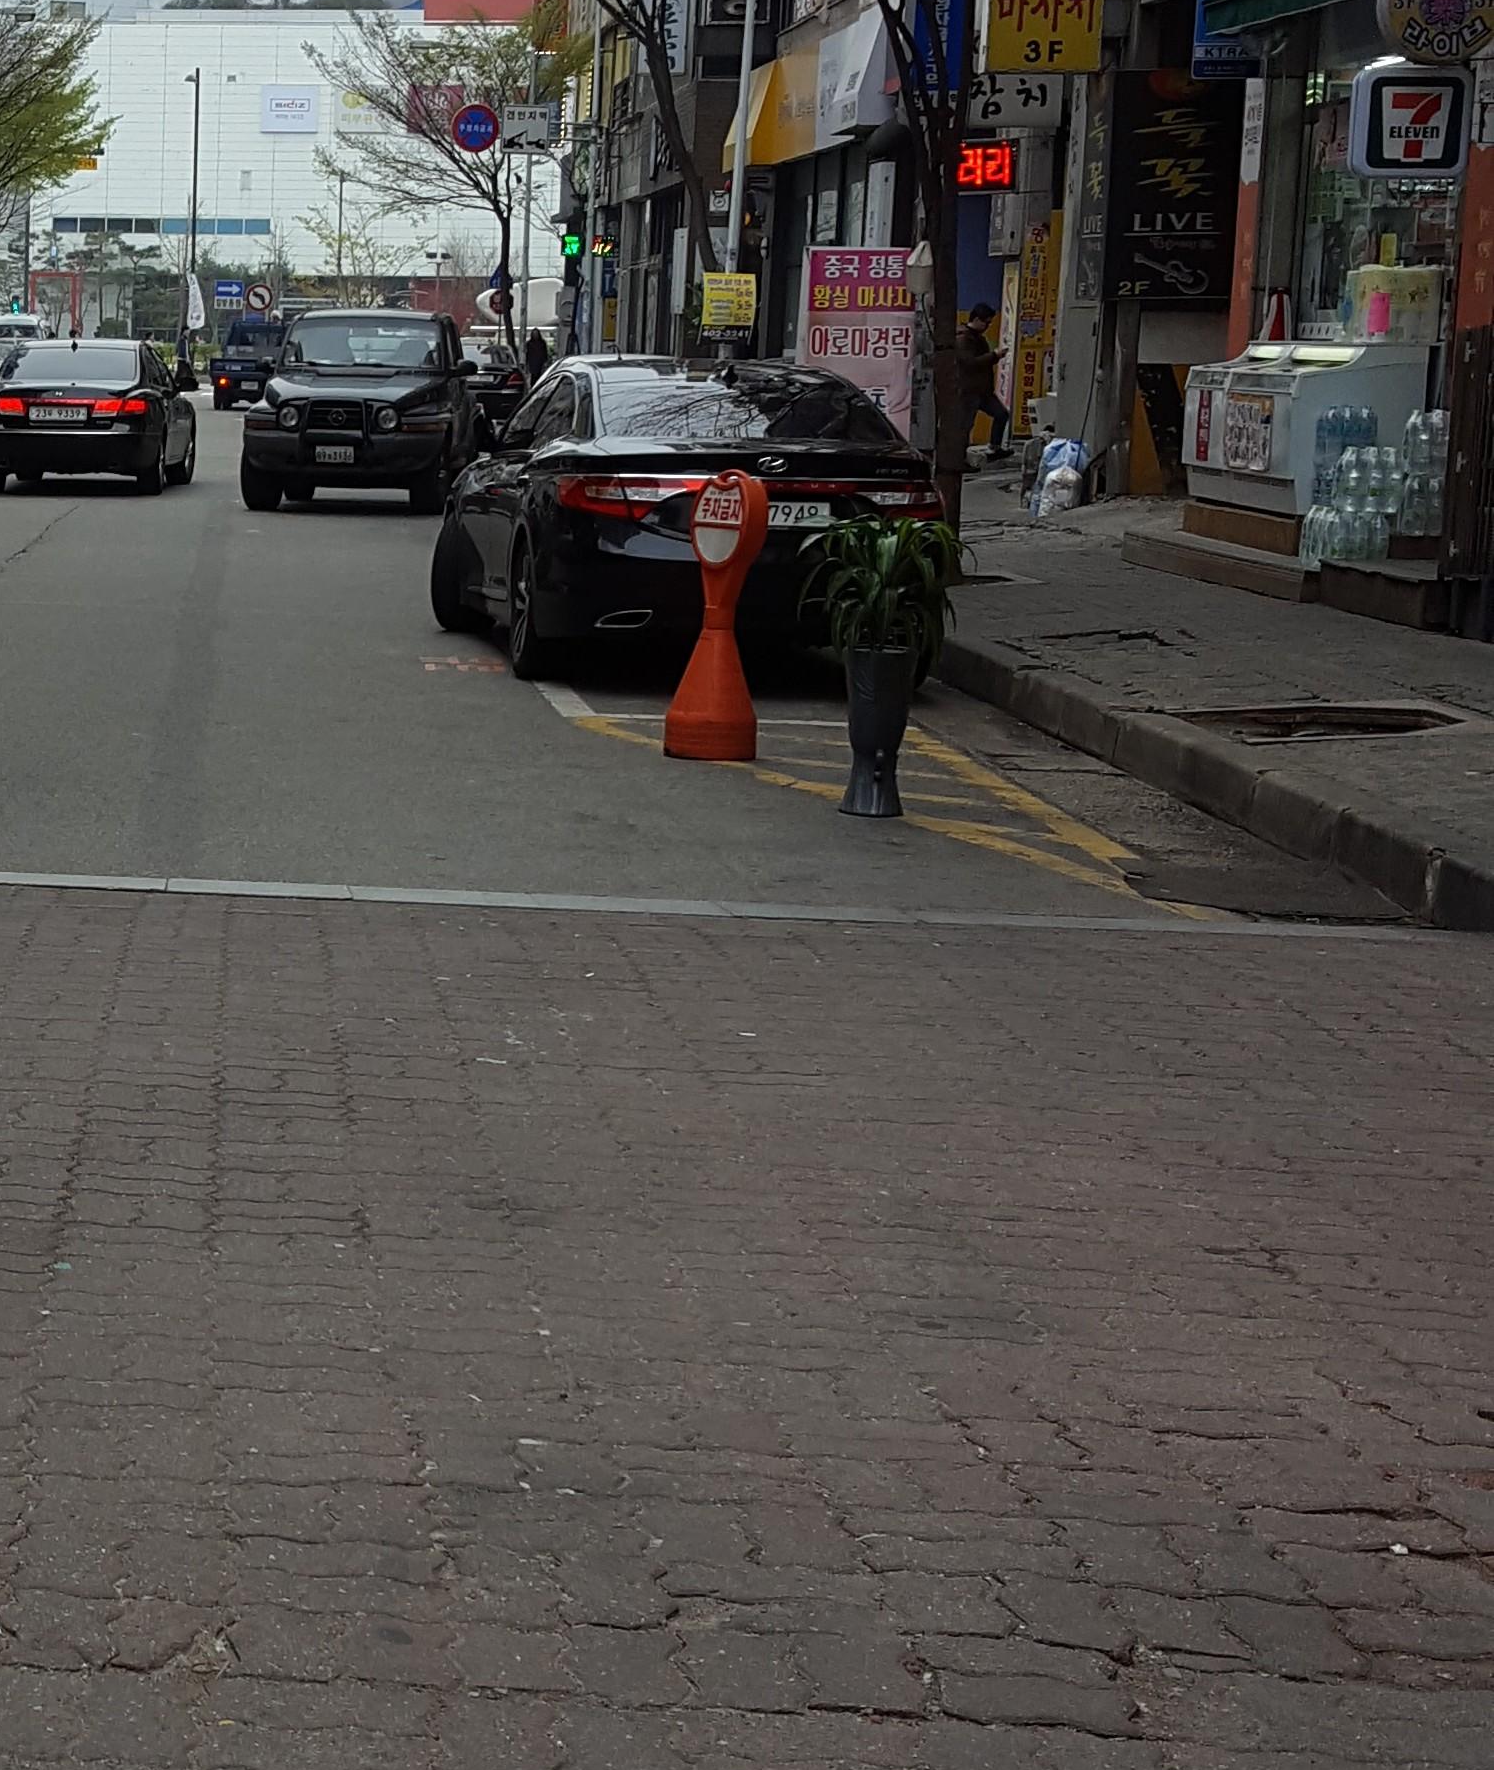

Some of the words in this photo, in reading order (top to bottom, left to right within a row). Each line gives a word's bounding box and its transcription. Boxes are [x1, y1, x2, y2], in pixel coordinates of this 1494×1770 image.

[1023, 39, 1064, 63] 3F
[1133, 212, 1215, 232] LIVE
[823, 255, 860, 279] 중국
[867, 255, 905, 279] 정통
[812, 284, 850, 309] 황실
